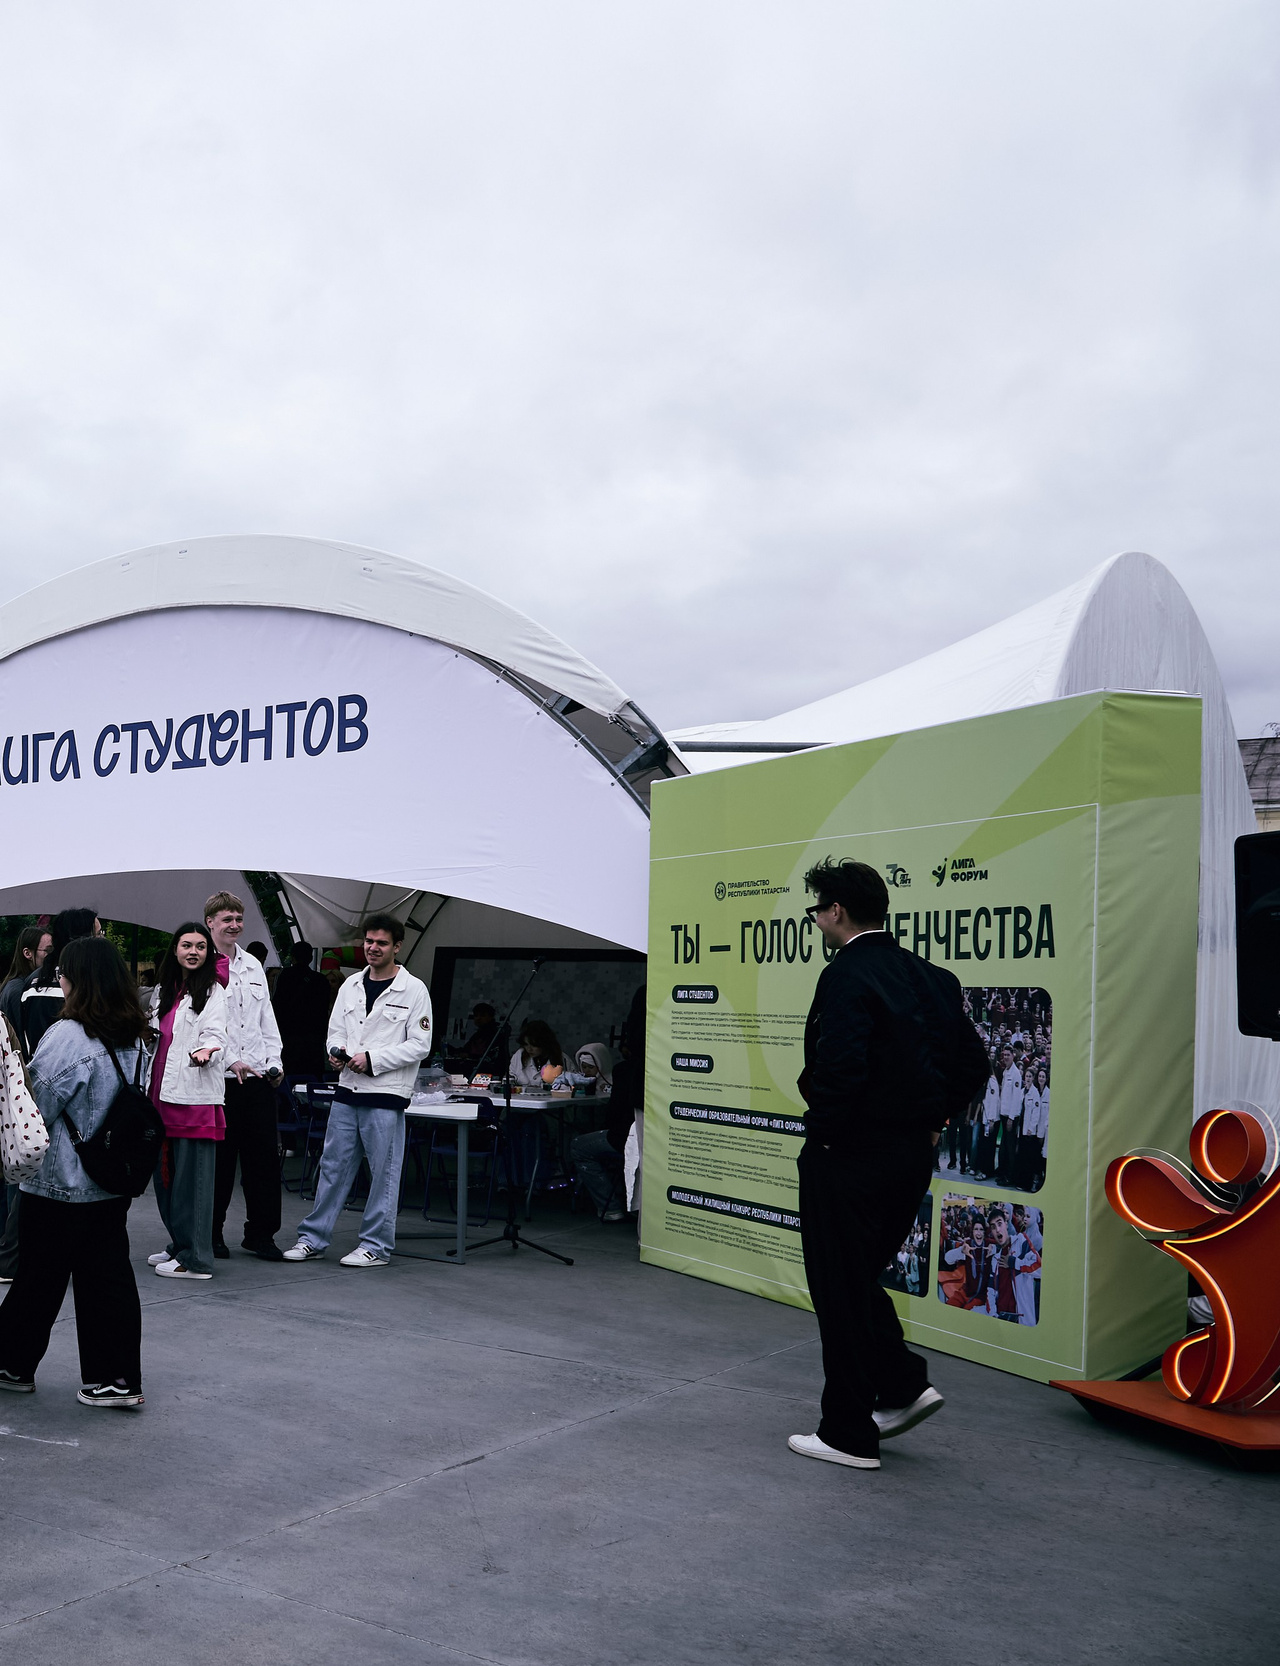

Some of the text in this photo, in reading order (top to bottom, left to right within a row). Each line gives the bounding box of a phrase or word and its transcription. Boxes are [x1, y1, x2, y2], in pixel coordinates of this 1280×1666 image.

[93, 693, 370, 778] СТУДЕНТОВ
[950, 858, 976, 870] ЛИГА
[727, 879, 770, 889] ПРАВИТЕЛЬСТВО
[950, 869, 989, 883] ФОРУМ
[727, 886, 790, 898] РЕСПУБЛИКИ ТАТАРСТАН
[671, 923, 700, 964] ТЫ
[740, 916, 813, 964] ГОЛОС
[822, 904, 1056, 963] ЕНЧЕСТВА
[674, 1106, 708, 1119] СТУДЕНЧЕСКИЙ
[708, 1110, 751, 1125] ОБРАЗОВАТЕЛЬНЫЙ
[751, 1116, 769, 1127] ФОРУМ
[731, 1203, 752, 1216] КОНКУРС
[751, 1208, 782, 1223] РЕСПУБЛИКИ
[782, 1214, 801, 1227] ТАТАРСТ
